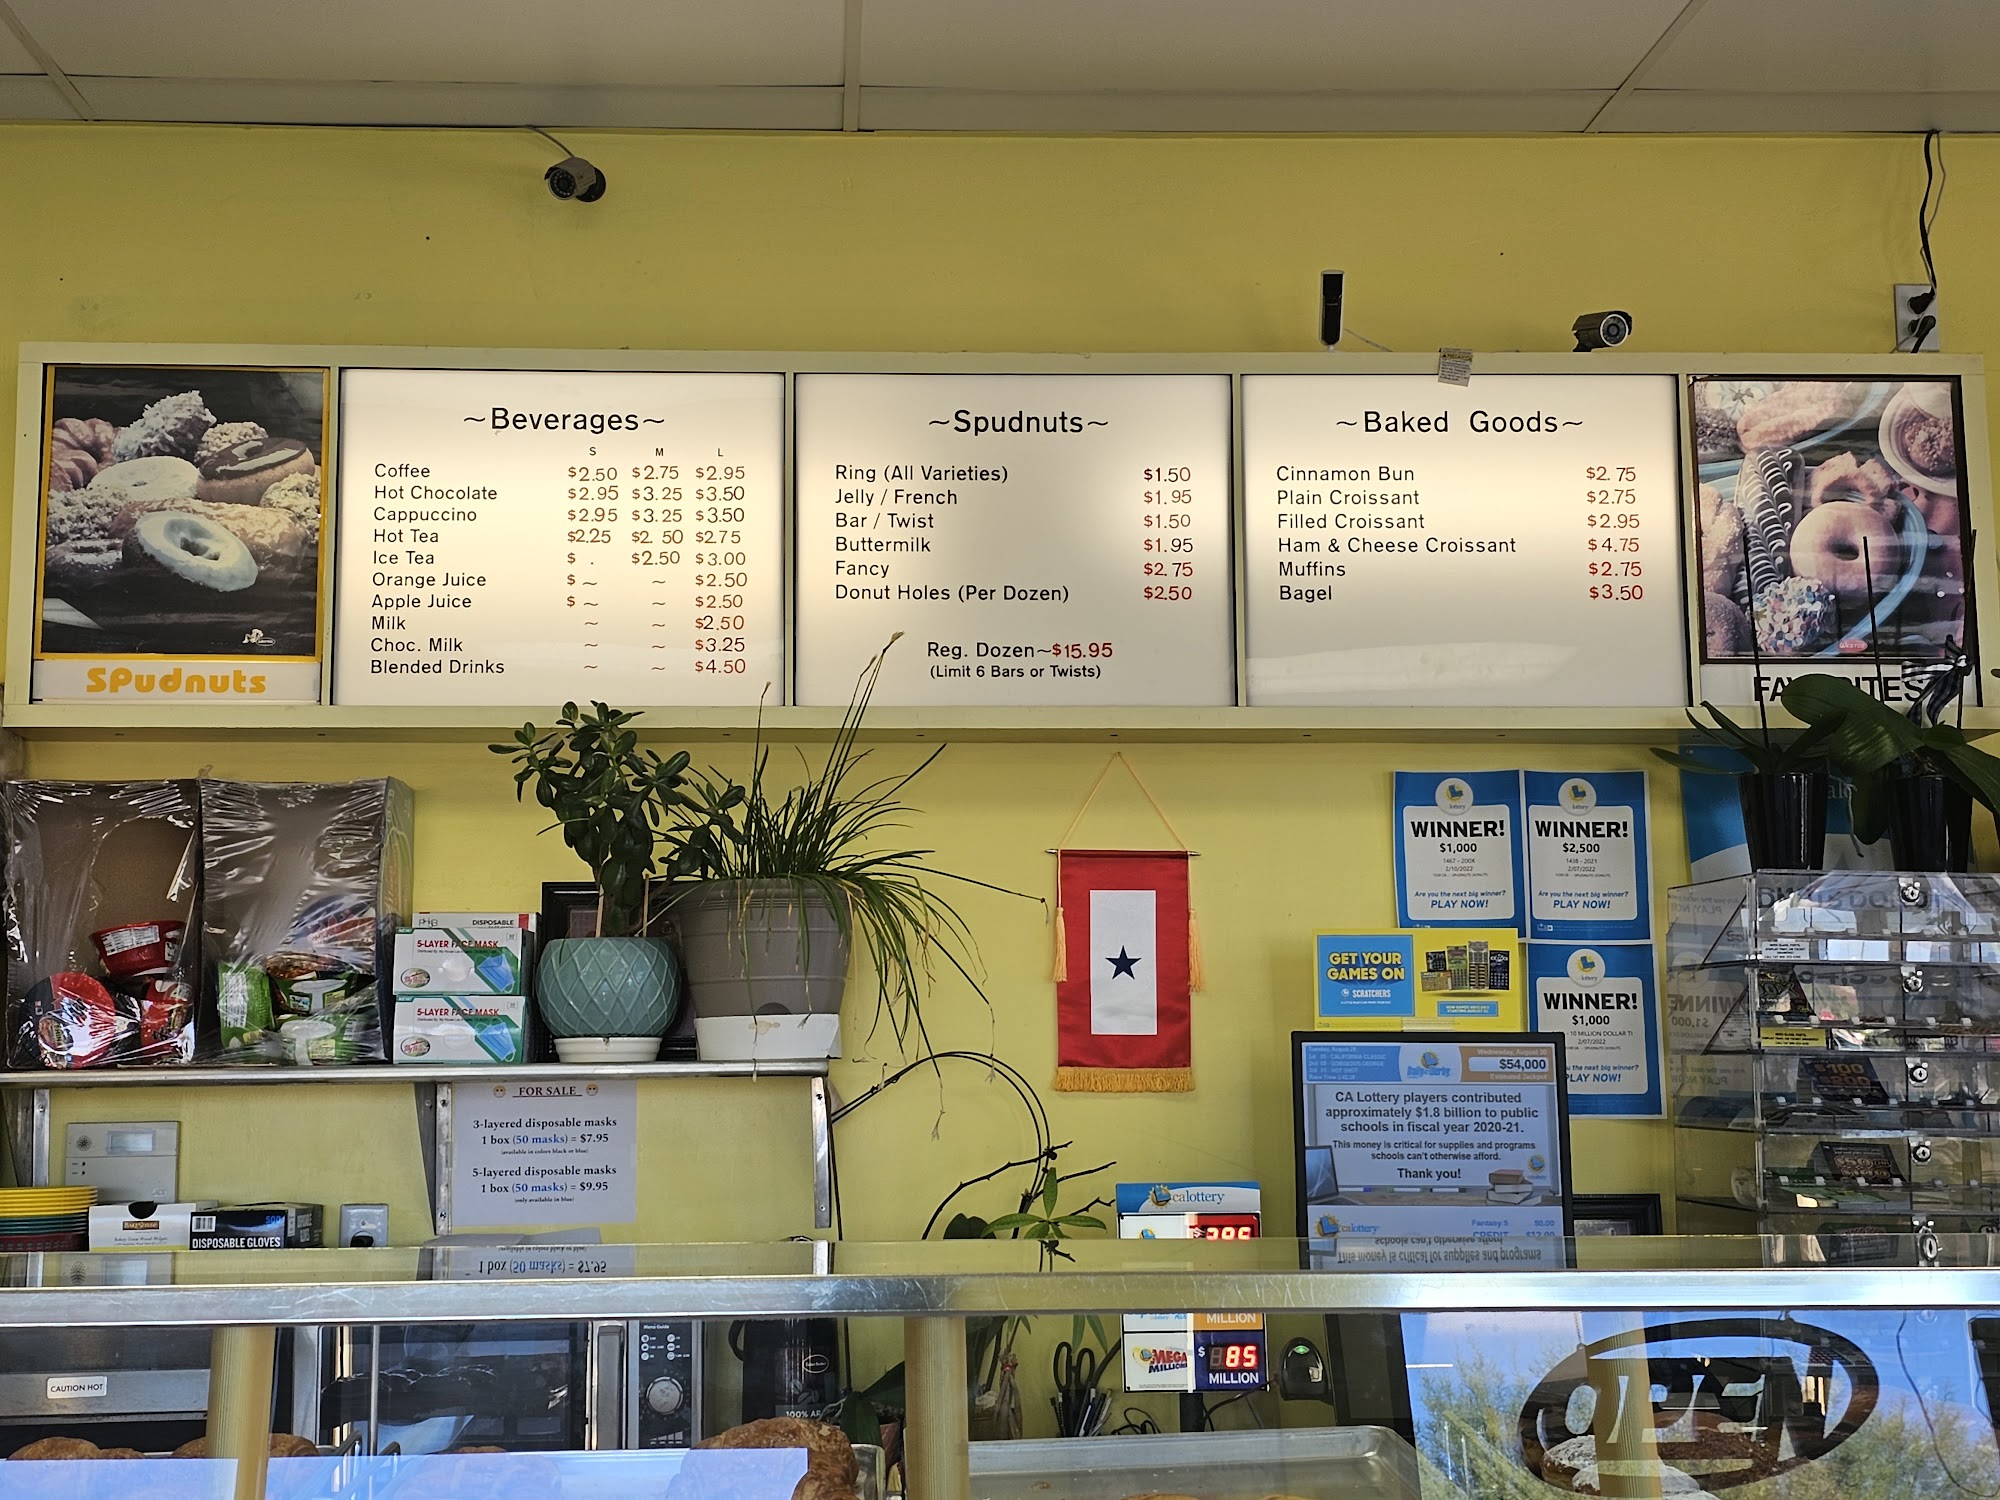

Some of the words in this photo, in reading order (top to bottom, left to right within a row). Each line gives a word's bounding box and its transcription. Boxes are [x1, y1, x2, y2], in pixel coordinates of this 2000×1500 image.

[375, 464, 430, 477] Coffee
[568, 467, 617, 481] $2.50
[632, 465, 678, 480] $2.75
[696, 466, 745, 480] $2.95
[836, 465, 875, 482] Ring
[885, 465, 912, 482] (All
[921, 466, 1007, 483] Varieties)
[1144, 467, 1190, 482] $1.50
[1277, 466, 1370, 481] Cinnamon
[1379, 466, 1413, 480] Bun
[1587, 466, 1636, 481] $2.75
[375, 486, 403, 499] Hot
[411, 486, 497, 499] Chocolate
[568, 486, 618, 500] $2.95
[632, 486, 682, 501] $3.25
[696, 486, 744, 501] $3.50
[374, 507, 476, 523] Cappuccino
[568, 507, 617, 522] $2.95
[632, 509, 682, 523] $3.25
[696, 507, 744, 523] $3.50
[1279, 514, 1326, 528] Filled
[1335, 514, 1424, 528] Croissant
[1588, 514, 1639, 528] $2.95
[836, 537, 930, 552] Buttermilk
[1144, 538, 1193, 552] $1.95
[1279, 538, 1320, 552] Ham
[1328, 539, 1340, 552] &
[1348, 537, 1418, 552] Cheese
[1426, 537, 1515, 552] Croissant
[1588, 538, 1639, 552] $4.75
[836, 561, 889, 578] Fancy
[1144, 562, 1193, 577] $2.75
[1280, 561, 1345, 576] Muffins
[1589, 562, 1641, 576] $2.75
[835, 583, 890, 599] Donut
[899, 585, 950, 600] Holes
[959, 585, 996, 602] (Per
[1004, 585, 1068, 603] Dozen)
[1144, 586, 1192, 600] $2.50
[1280, 585, 1331, 603] Bagel
[1590, 584, 1643, 600] $3.50
[928, 642, 967, 659] Reg.
[371, 660, 441, 673] Blended
[450, 660, 504, 673] Drinks
[696, 659, 745, 673] $4.50
[931, 665, 970, 679] (Limit
[977, 666, 985, 677] 6
[992, 665, 1024, 677] Bars
[1030, 668, 1044, 677] or
[1050, 665, 1100, 679] Twists)
[1410, 820, 1504, 837] WINNER!
[1533, 820, 1628, 839] WINNER!
[1440, 843, 1477, 853] $1,000
[1563, 843, 1600, 853] $2,500
[1430, 900, 1457, 909] PLAY
[1553, 900, 1580, 909] PLAY
[1583, 900, 1611, 909] NOW!
[417, 939, 449, 948] 5-LAYER
[451, 939, 473, 948] FACE
[475, 939, 499, 948] MASK
[1329, 952, 1358, 965] GET
[1362, 952, 1402, 965] YOUR
[1327, 967, 1379, 980] GAMES
[1381, 967, 1405, 980] ON
[1352, 989, 1391, 998] SCRATCHERS
[1542, 992, 1639, 1011] WINNER!
[1572, 1015, 1609, 1026] $1,000
[1499, 1058, 1546, 1071] $54,000
[546, 1086, 576, 1095] SALE
[1336, 1092, 1353, 1102] CA
[1357, 1092, 1399, 1105] Lottery
[1404, 1092, 1447, 1105] players
[1452, 1092, 1521, 1103] contributed
[1326, 1107, 1411, 1120] approximately
[1416, 1107, 1440, 1117] $1.8
[1444, 1107, 1481, 1117] billion
[1485, 1108, 1497, 1117] to
[1501, 1107, 1538, 1120] public
[474, 1119, 521, 1130] 3-layered
[526, 1118, 581, 1130] disposable
[585, 1117, 616, 1126] masks
[1341, 1121, 1389, 1131] schools
[1393, 1121, 1403, 1131] in
[1407, 1122, 1440, 1132] fiscal
[1444, 1124, 1469, 1134] year
[1474, 1122, 1524, 1132] 2020-21.
[491, 1135, 509, 1144] box
[532, 1134, 567, 1143] masks)
[581, 1134, 608, 1143] $7.95
[1331, 1140, 1351, 1151] This
[1439, 1141, 1474, 1151] supplies
[1430, 1150, 1471, 1160] otherwise
[473, 1167, 521, 1179] 5-layered
[525, 1166, 580, 1178] disposable
[584, 1165, 616, 1174] masks
[1397, 1168, 1432, 1178] Thank
[1436, 1169, 1461, 1181] you!
[532, 1182, 567, 1191] masks)
[580, 1182, 608, 1191] $9.95
[192, 1238, 245, 1249] DISPOSABLE
[247, 1237, 281, 1248] GLOVES
[1206, 1313, 1257, 1323] MILLION
[1150, 1349, 1188, 1365] MEGA
[1198, 1346, 1206, 1358] $
[1225, 1345, 1257, 1368] 85
[1208, 1372, 1259, 1384] MILLION
[785, 1410, 808, 1418] 100%
